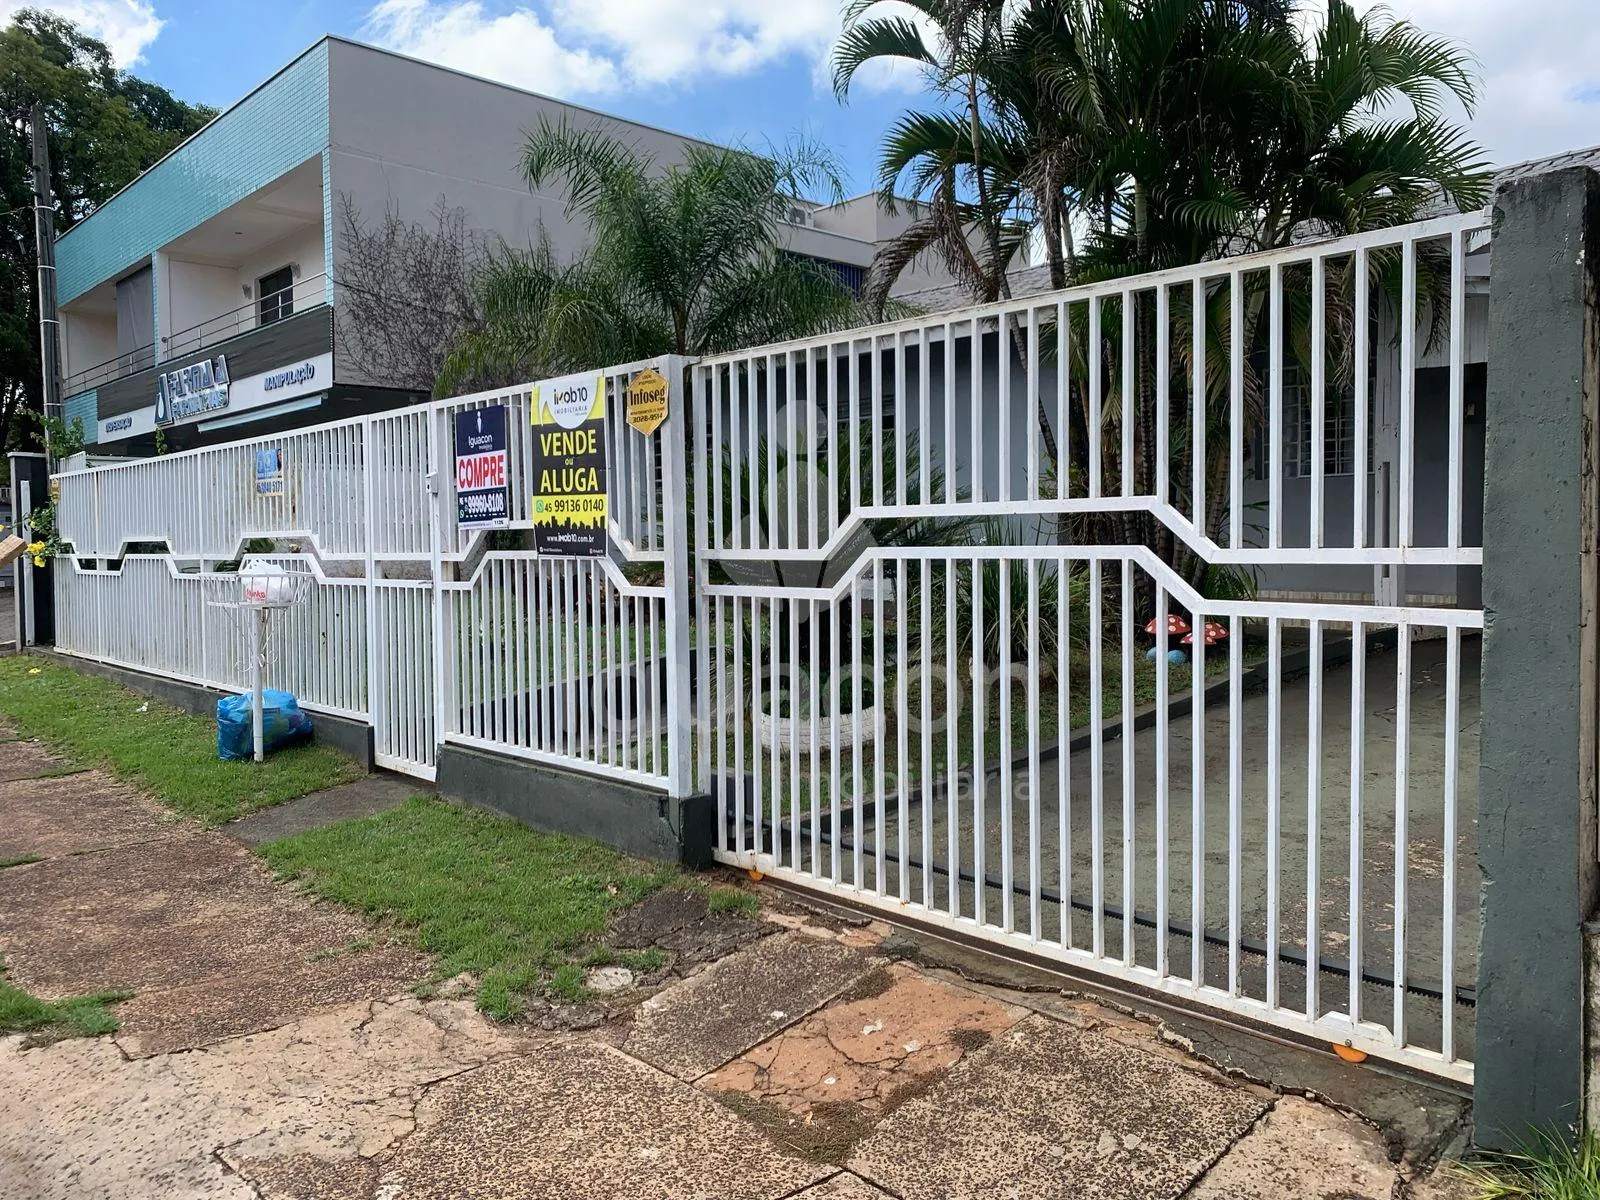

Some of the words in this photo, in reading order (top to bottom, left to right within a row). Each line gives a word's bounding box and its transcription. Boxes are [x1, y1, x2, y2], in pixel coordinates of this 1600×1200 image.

[264, 362, 315, 391] MANIPULAÇÃO
[630, 385, 665, 406] Infoseg
[540, 429, 597, 456] VENDE
[458, 454, 504, 489] COMPRE
[540, 467, 599, 493] ALUGA
[554, 499, 581, 512] 99136
[582, 498, 604, 512] 0140
